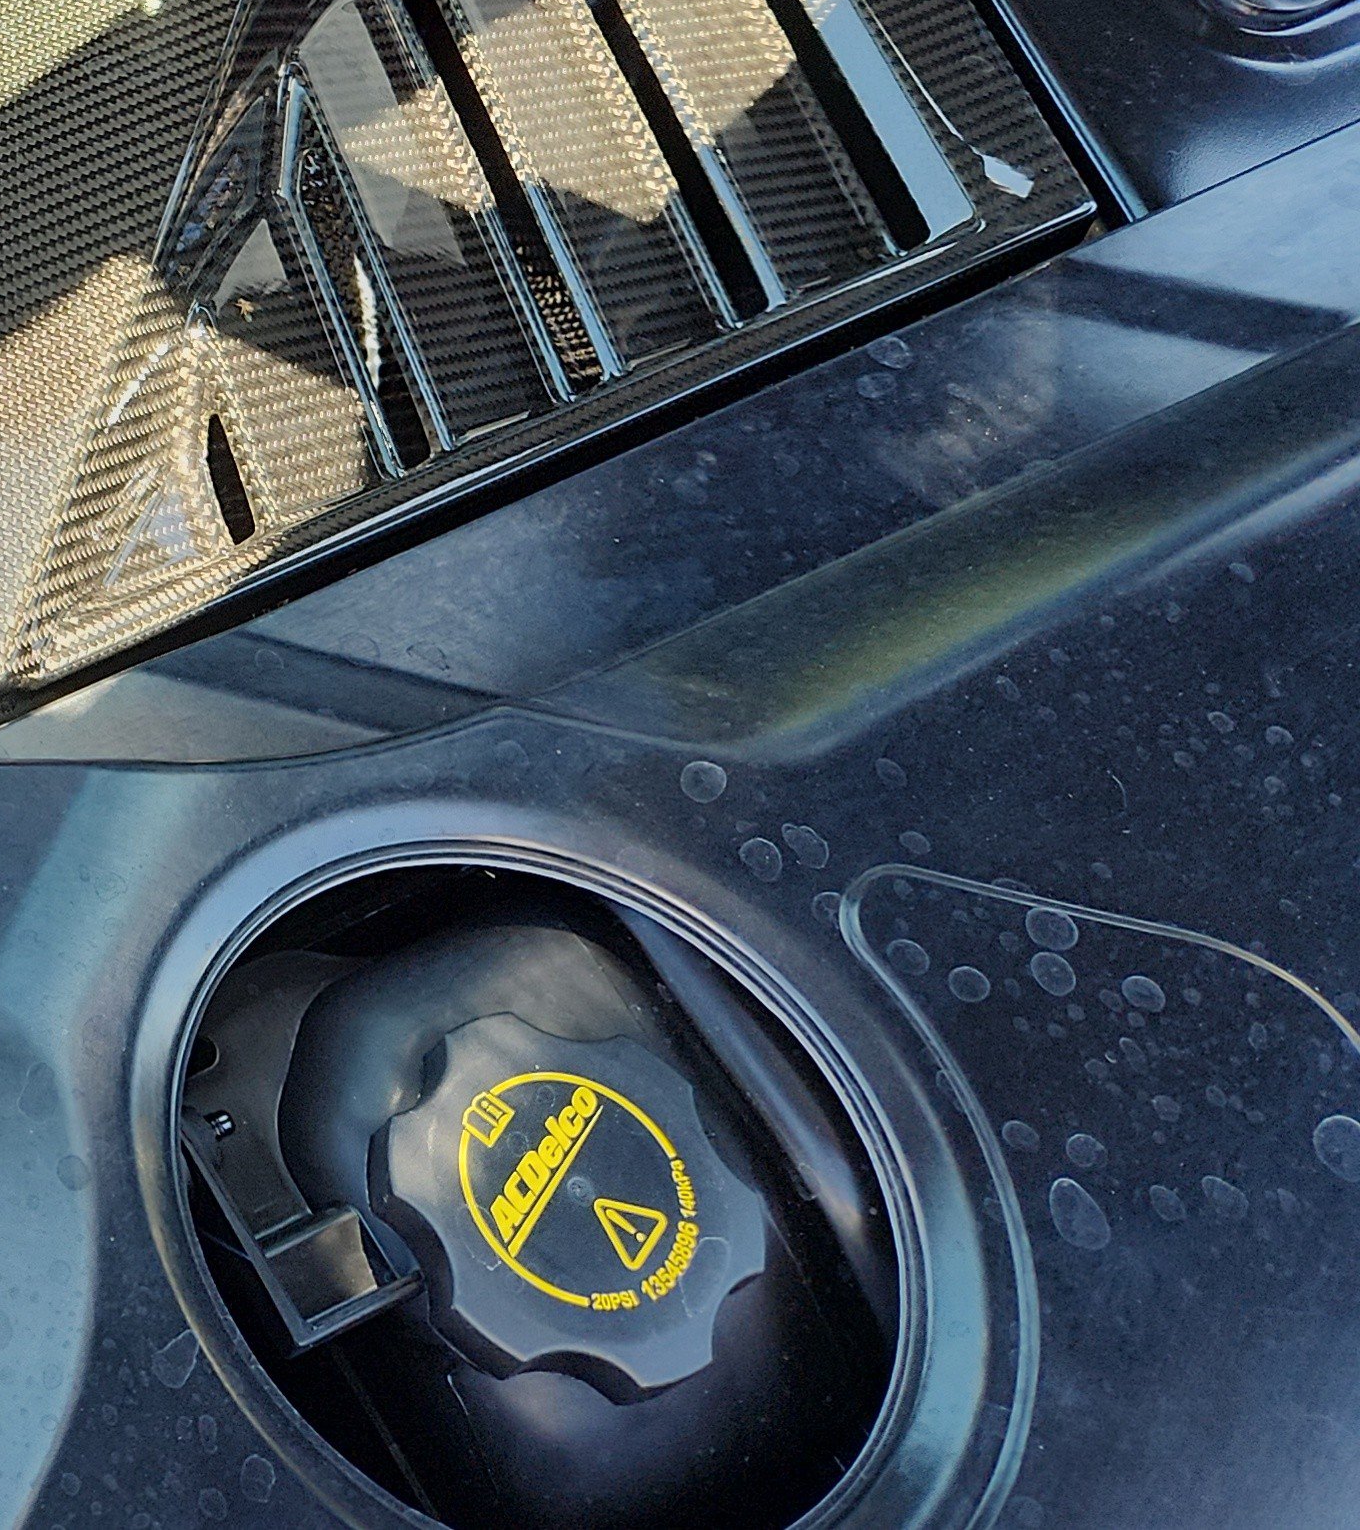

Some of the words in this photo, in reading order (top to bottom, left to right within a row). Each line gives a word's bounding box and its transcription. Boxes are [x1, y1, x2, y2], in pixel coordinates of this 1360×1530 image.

[489, 1085, 599, 1244] ACDelco
[591, 1290, 640, 1312] 20PSI
[641, 1221, 700, 1301] 13545896
